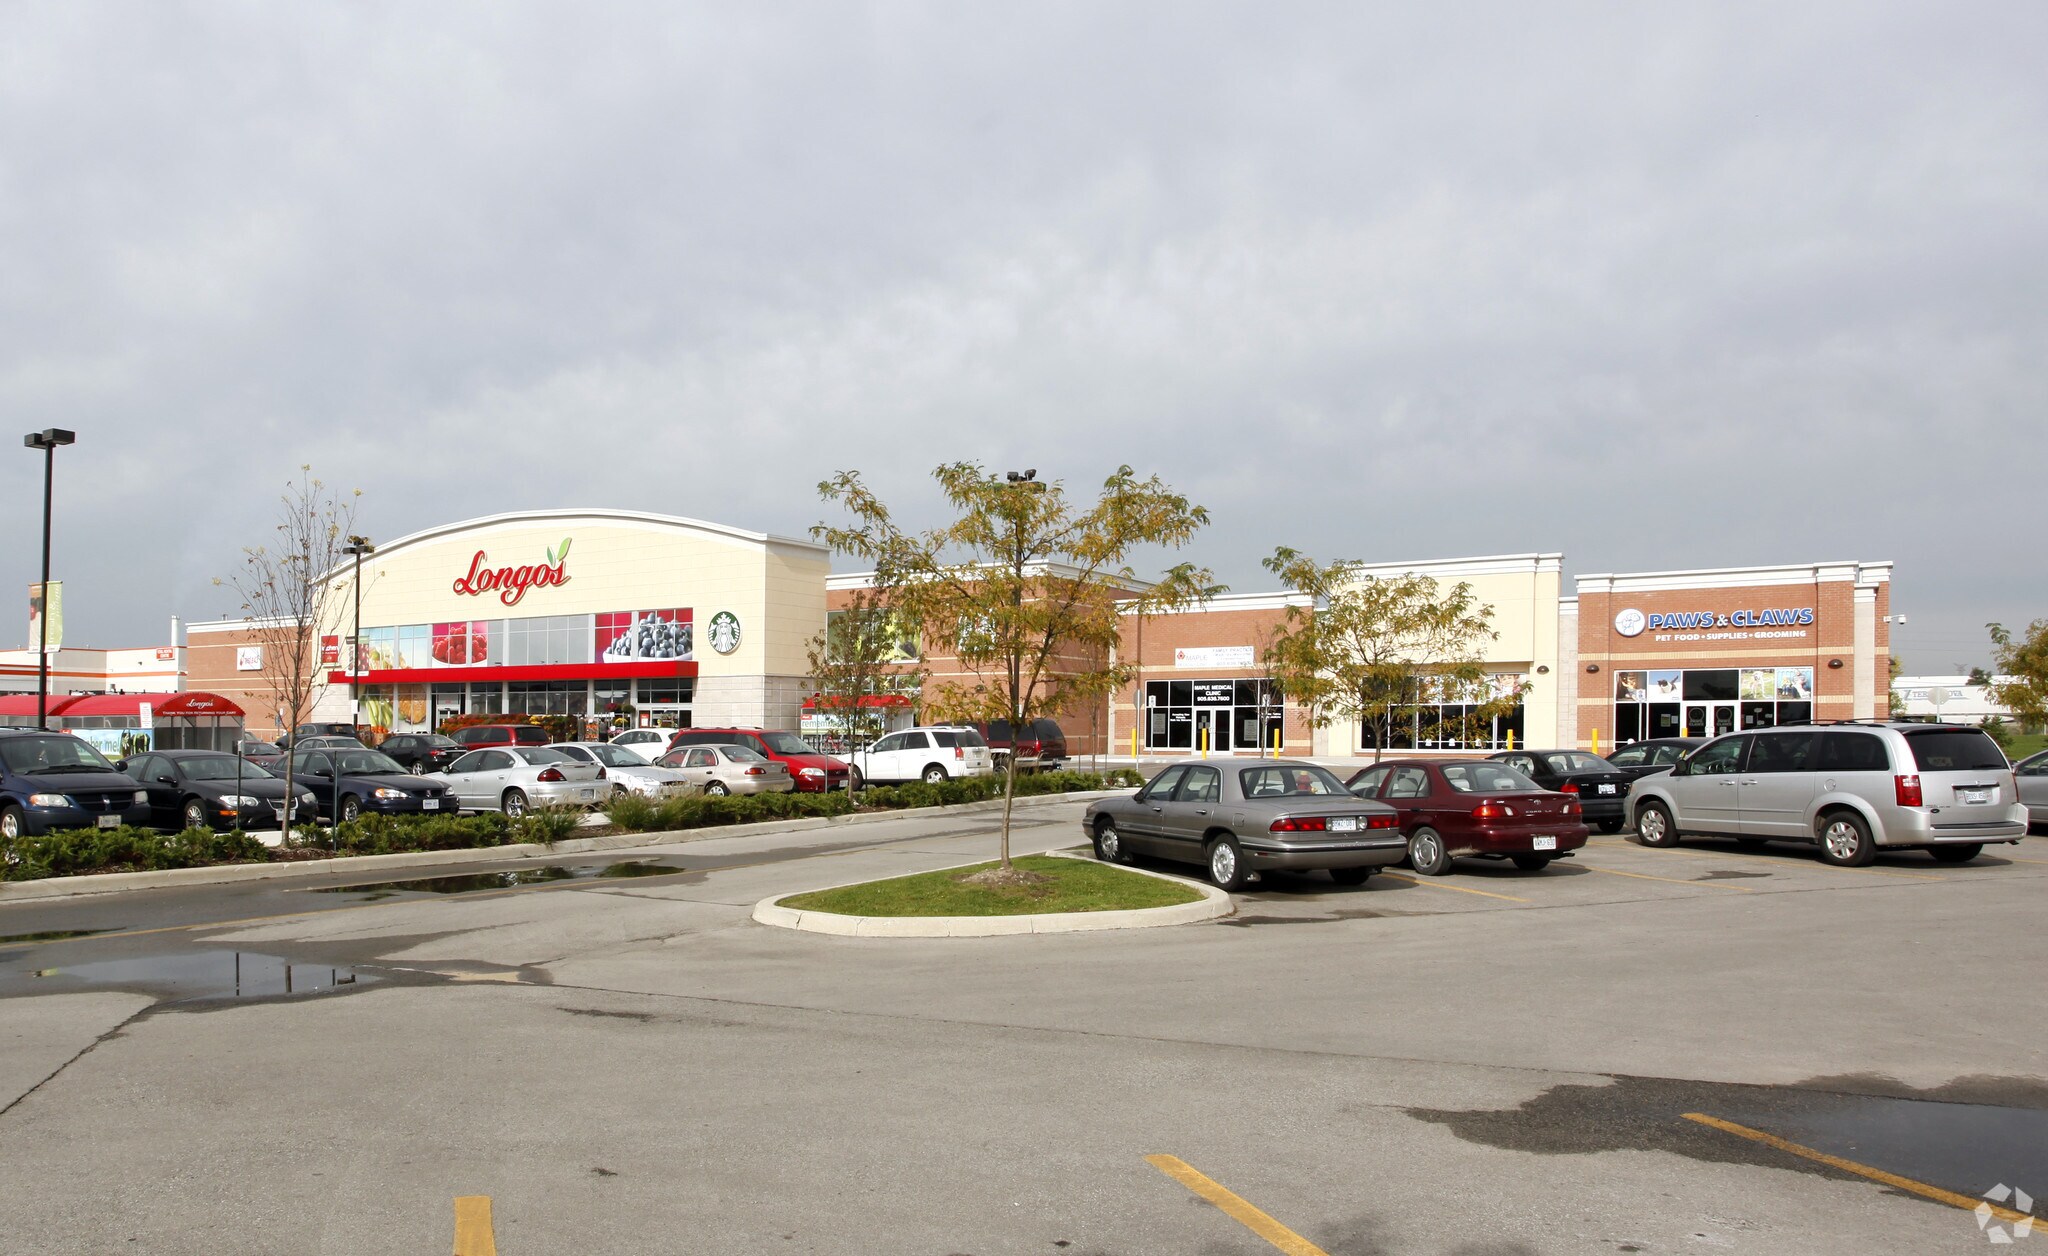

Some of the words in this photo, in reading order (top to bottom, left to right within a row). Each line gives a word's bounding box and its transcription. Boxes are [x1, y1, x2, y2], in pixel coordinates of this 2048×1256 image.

[1648, 611, 1714, 629] PAWS
[1716, 614, 1729, 627] &
[1730, 608, 1815, 627] CLAWS
[1655, 634, 1671, 642] PET
[1674, 633, 1700, 641] FOOD
[1706, 632, 1748, 640] SUPPLIES
[1754, 630, 1807, 639] GROOMING
